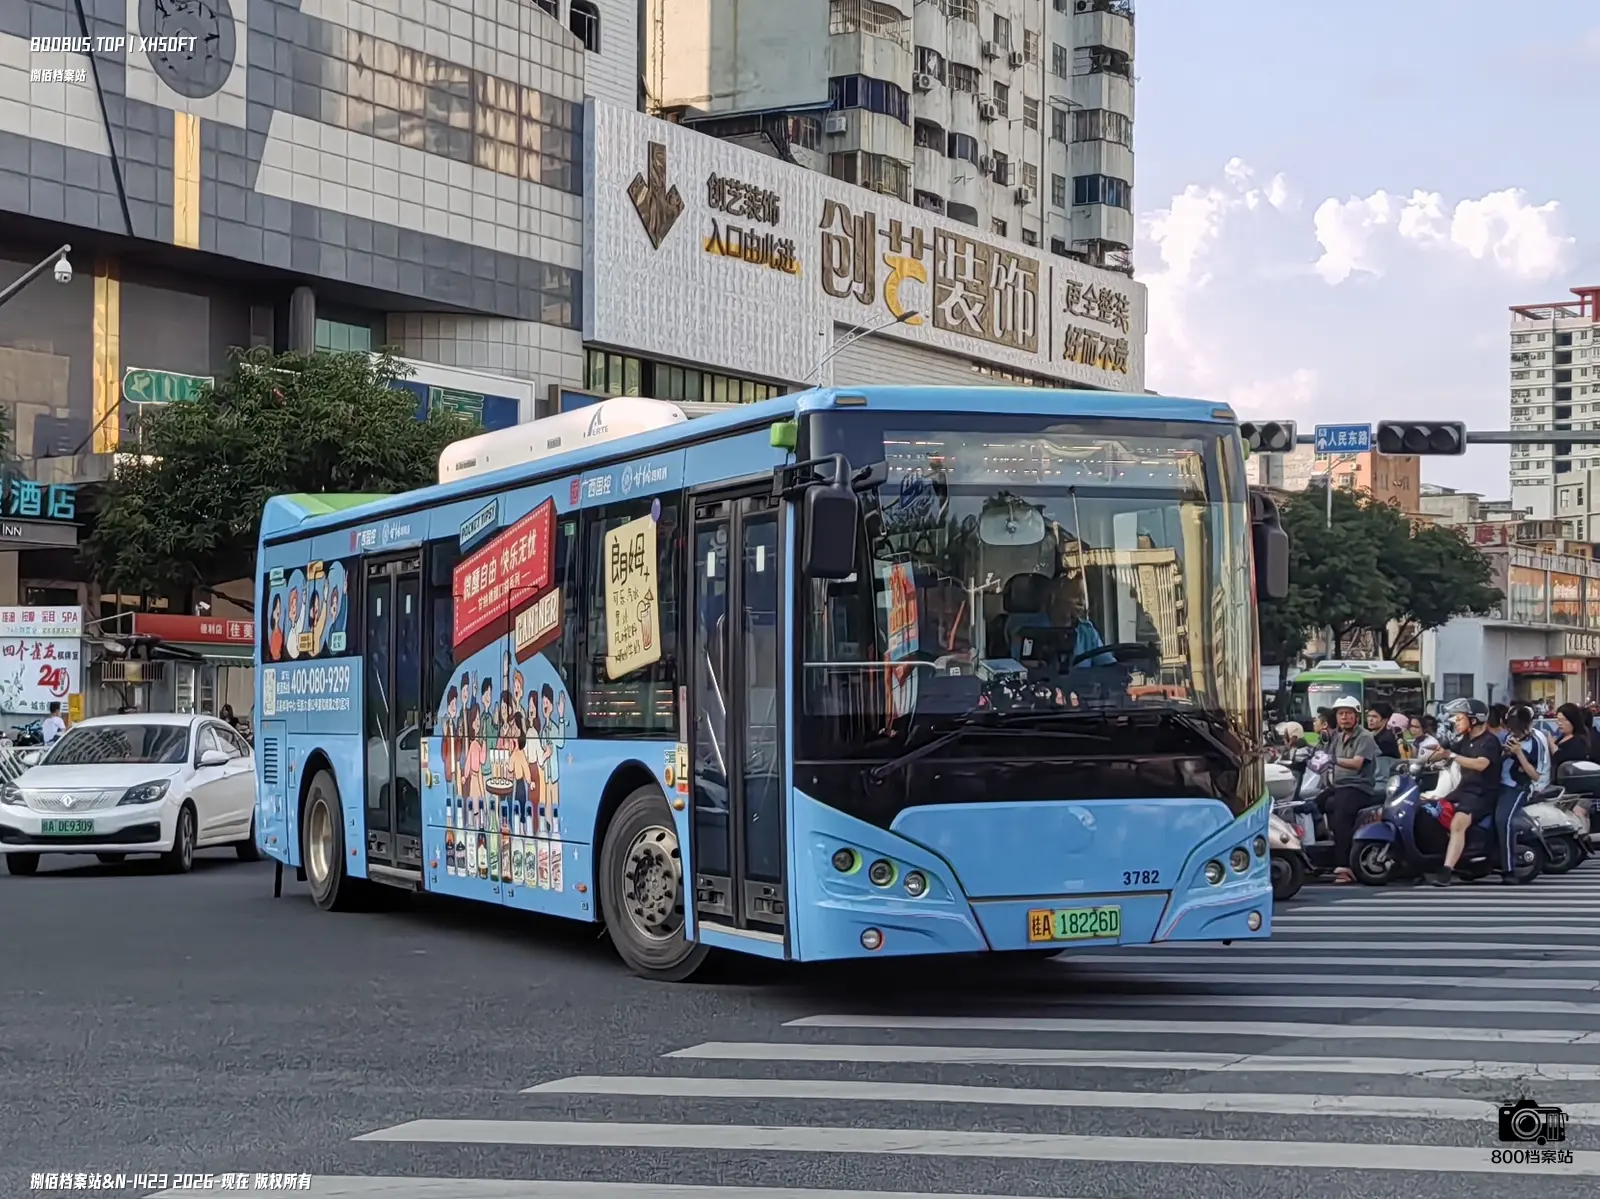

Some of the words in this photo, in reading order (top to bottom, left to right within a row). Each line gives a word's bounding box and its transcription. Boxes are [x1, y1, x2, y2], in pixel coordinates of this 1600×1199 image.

[706, 172, 781, 227] 创艺装饰
[705, 218, 798, 275] 入口由此进
[819, 199, 1037, 347] 创艺装饰
[1063, 279, 1130, 335] 更全整装
[1063, 324, 1130, 375] 好而不贵
[1328, 430, 1369, 447] 人民东路
[0, 479, 78, 519] 酒店
[2, 523, 22, 537] INN
[611, 533, 645, 586] 朗姆
[62, 611, 79, 623] SPA
[37, 664, 61, 690] 24
[291, 665, 350, 694] 400-080-9299
[677, 756, 688, 781] 上
[1122, 869, 1160, 886] 3782
[1060, 910, 1120, 935] 18226D
